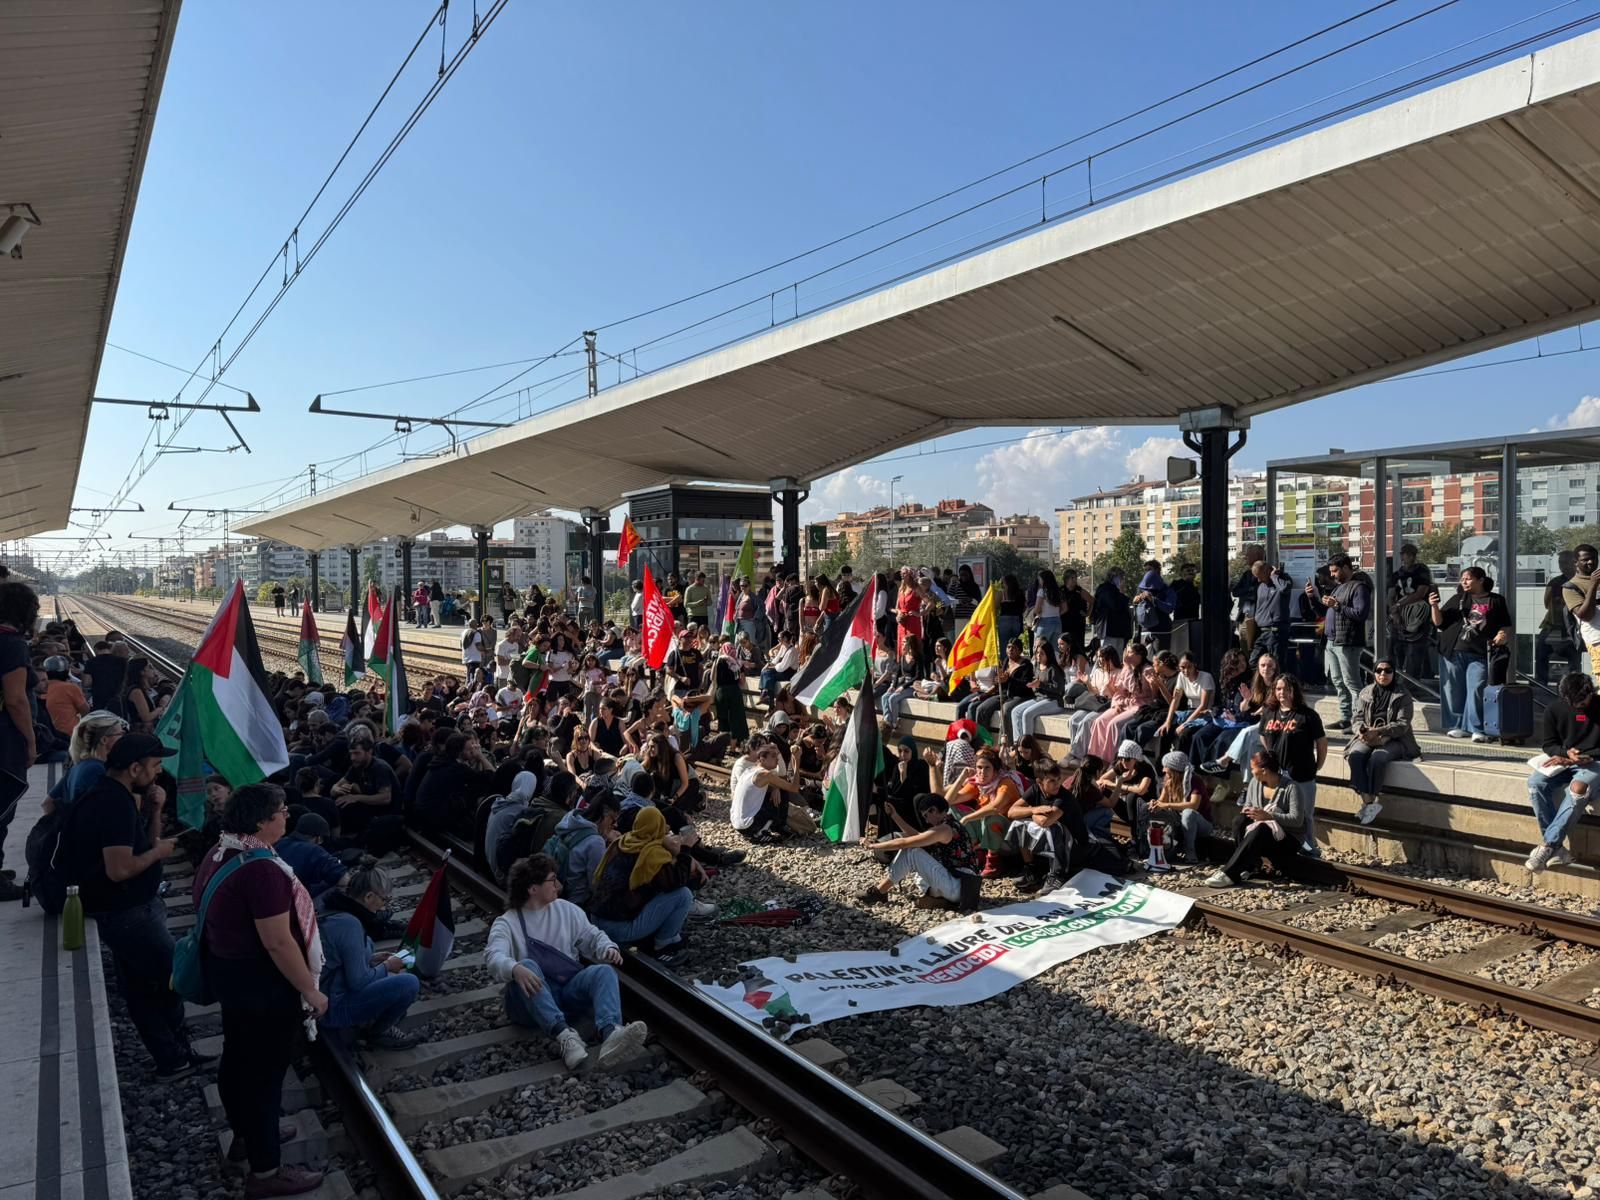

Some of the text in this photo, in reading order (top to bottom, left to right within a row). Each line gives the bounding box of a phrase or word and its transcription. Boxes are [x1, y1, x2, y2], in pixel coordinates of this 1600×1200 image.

[784, 965, 923, 984] PALESTINA
[918, 928, 997, 967] LLIURE
[994, 922, 1041, 935] DEL
[924, 944, 1005, 981] GENOCIDI
